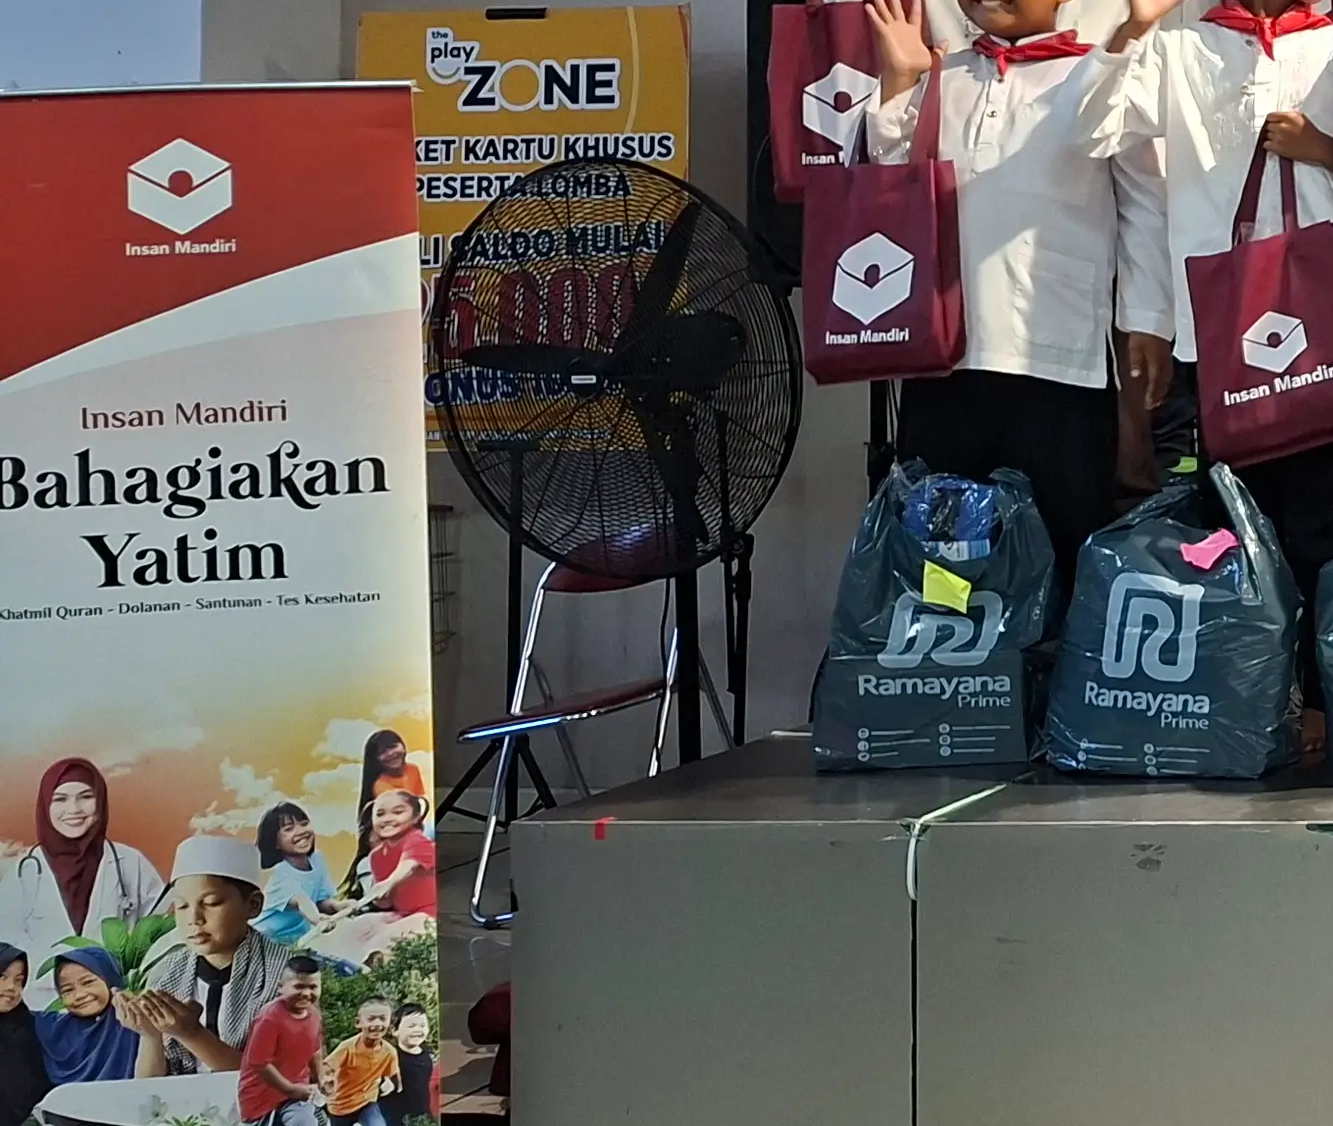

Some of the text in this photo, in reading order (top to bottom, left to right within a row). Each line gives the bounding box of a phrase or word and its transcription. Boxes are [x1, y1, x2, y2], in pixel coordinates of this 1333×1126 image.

[431, 30, 449, 40] the
[430, 42, 475, 64] play
[461, 63, 617, 107] ZONE
[464, 137, 556, 162] KARTU
[564, 134, 674, 161] KHUSUS
[801, 152, 836, 166] Insan
[536, 173, 631, 199] LOMBA
[125, 237, 237, 257] Insan Mandiri
[567, 221, 665, 255] MULAI
[825, 328, 910, 346] Insan Mandiri
[1223, 383, 1271, 407] Insan
[81, 400, 288, 430] Insan Mandiri
[0, 440, 392, 519] Bahagiakan
[80, 528, 289, 589] Yatim
[56, 606, 103, 620] Quran
[118, 599, 181, 616] Dolanan
[195, 595, 263, 610] Santunan
[277, 593, 300, 607] Tes
[305, 590, 381, 605] Kesehatan
[858, 674, 1012, 699] Ramayana
[1085, 681, 1210, 714] Ramayana
[957, 694, 1012, 709] Prime
[1160, 710, 1210, 730] Prime
